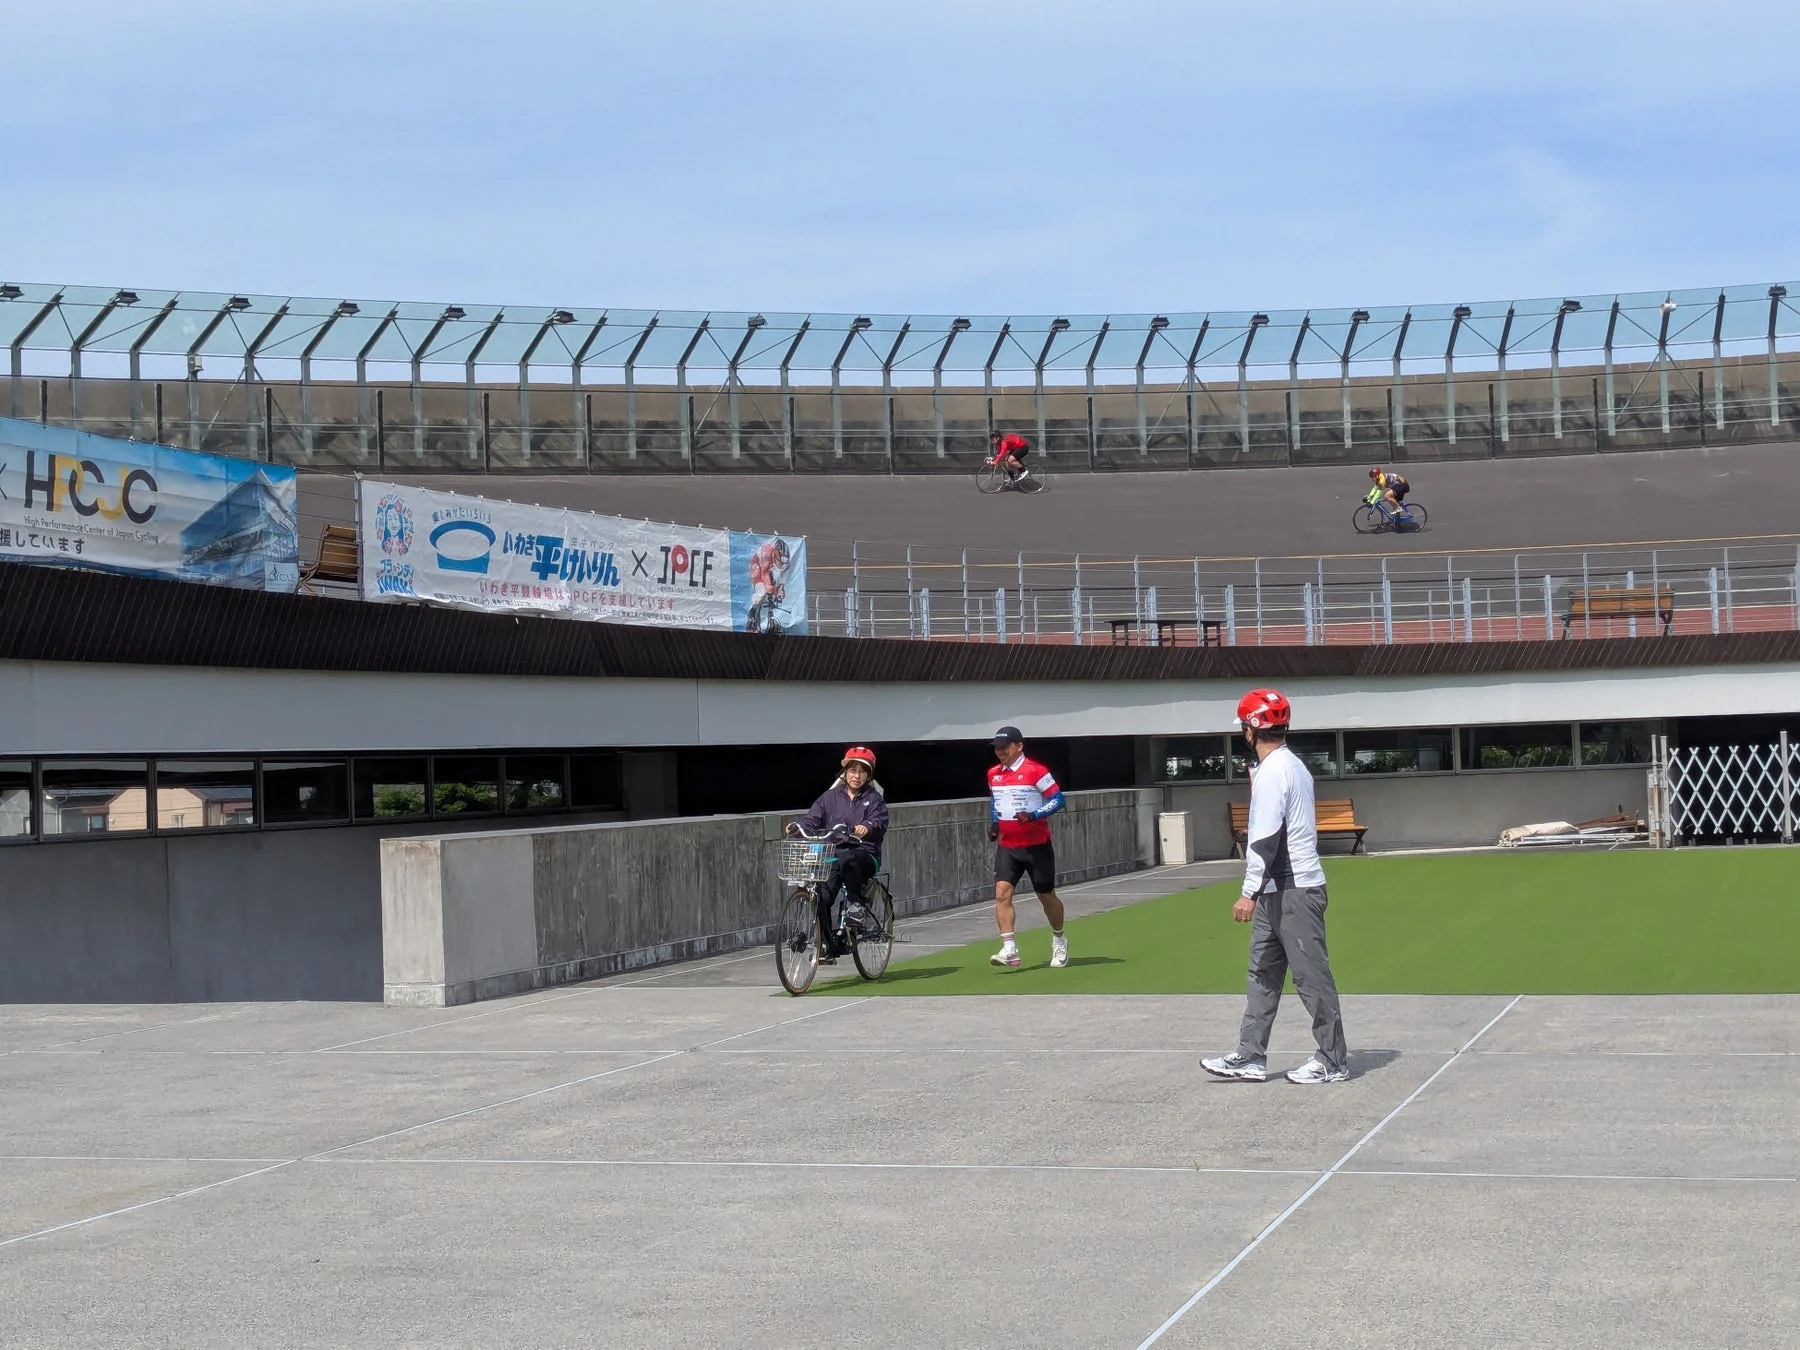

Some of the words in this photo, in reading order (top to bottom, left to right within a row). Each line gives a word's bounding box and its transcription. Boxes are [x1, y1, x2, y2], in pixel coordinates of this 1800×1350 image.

[25, 450, 158, 524] HPCJC
[24, 515, 40, 529] High
[41, 518, 83, 533] Performance
[84, 523, 105, 535] Center
[107, 527, 114, 536] of
[116, 528, 134, 541] Japan
[136, 530, 159, 545] Cycling
[657, 544, 714, 588] JPCF
